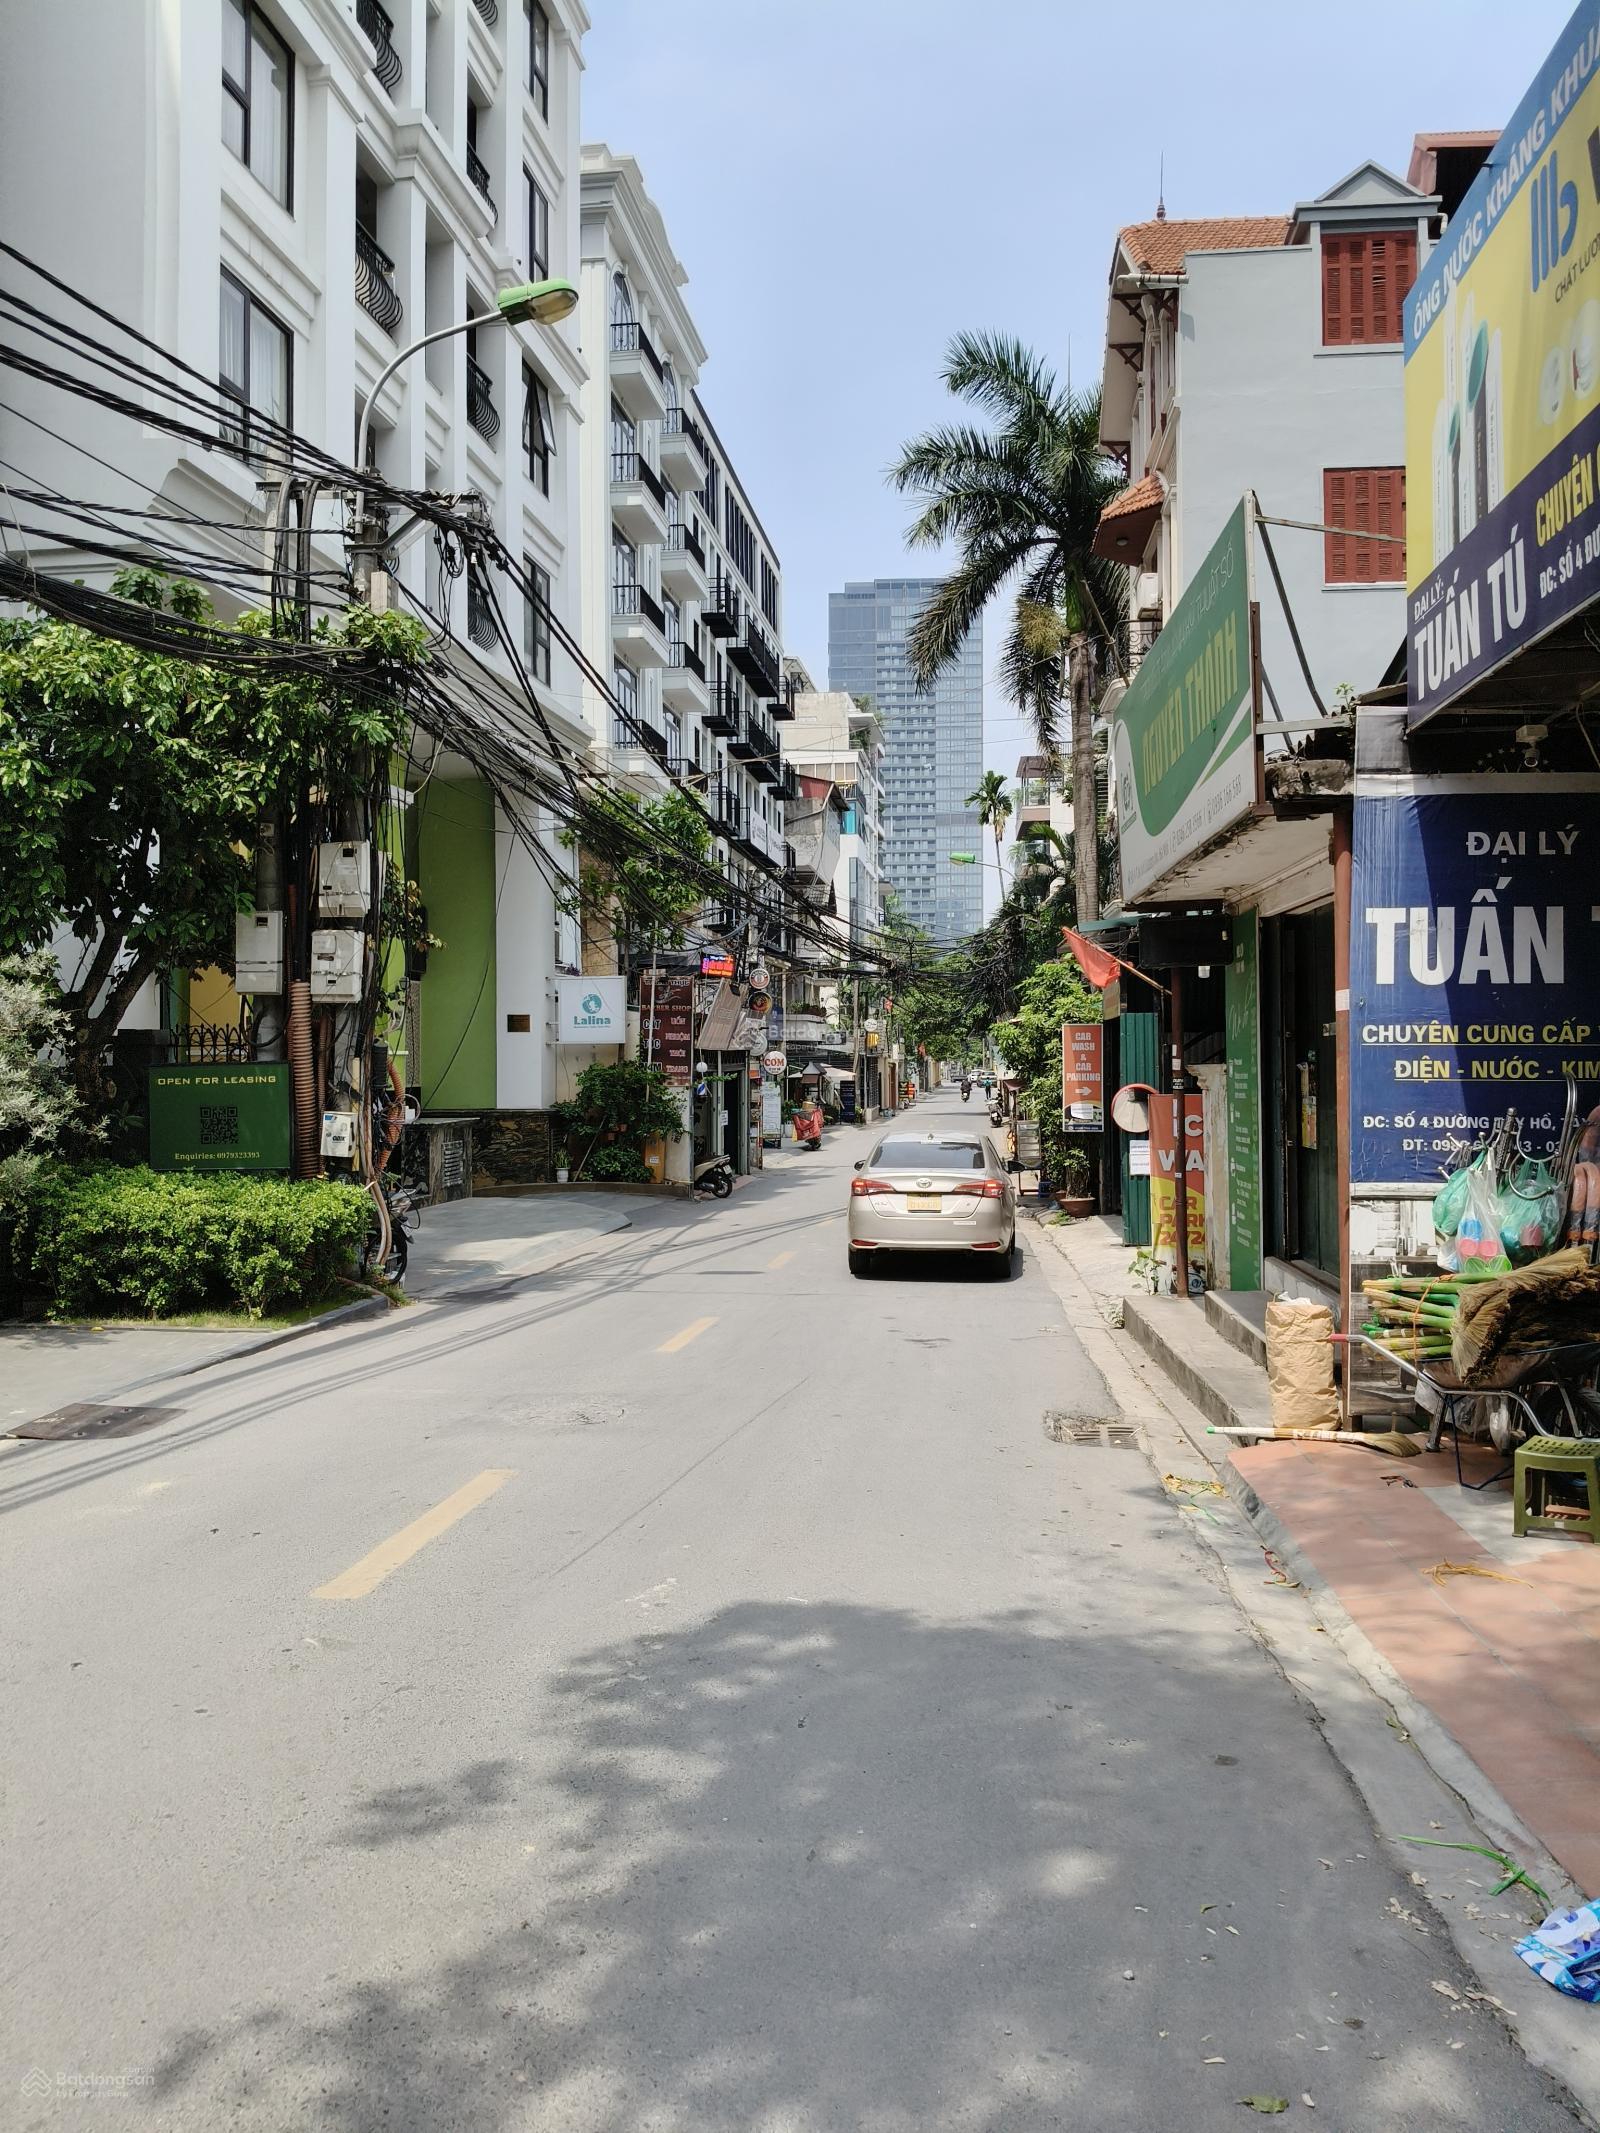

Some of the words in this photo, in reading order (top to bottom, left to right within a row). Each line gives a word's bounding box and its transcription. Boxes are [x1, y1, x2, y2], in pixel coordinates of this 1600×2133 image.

[1413, 278, 1441, 340] ỐNG
[1443, 209, 1483, 296] NƯỚC
[1487, 108, 1546, 225] KHÁNG
[1536, 453, 1594, 547] CHUYÊN
[1558, 539, 1574, 584] SỐ
[1575, 543, 1583, 570] 4
[1414, 567, 1481, 700] TUẤN
[1487, 523, 1527, 643] TÚ
[1466, 831, 1526, 863] ĐẠI
[1539, 824, 1582, 855] LÝ
[1366, 876, 1564, 985] TUẤN
[573, 1016, 611, 1025] Lalina
[1362, 1020, 1459, 1043] CHUYÊN
[1467, 1024, 1534, 1043] CUNG
[1542, 1017, 1590, 1043] CẤP
[1071, 1042, 1096, 1051] WASH
[1066, 1072, 1101, 1082] PARKING
[1075, 1062, 1092, 1071] CAR
[1394, 1055, 1450, 1083] ĐIỆN
[1472, 1056, 1540, 1079] NƯỚC
[157, 1077, 191, 1086] OPEN
[195, 1076, 219, 1085] FOR
[223, 1075, 277, 1084] LEASING
[1363, 1116, 1389, 1129] ĐC:
[1394, 1111, 1415, 1129] SỐ
[1419, 1116, 1428, 1128] 4
[1433, 1114, 1489, 1129] ĐƯỜNG
[1530, 1113, 1556, 1131] HỒ,
[1402, 1138, 1428, 1151] ĐT:
[174, 1152, 216, 1162] Enquiries:
